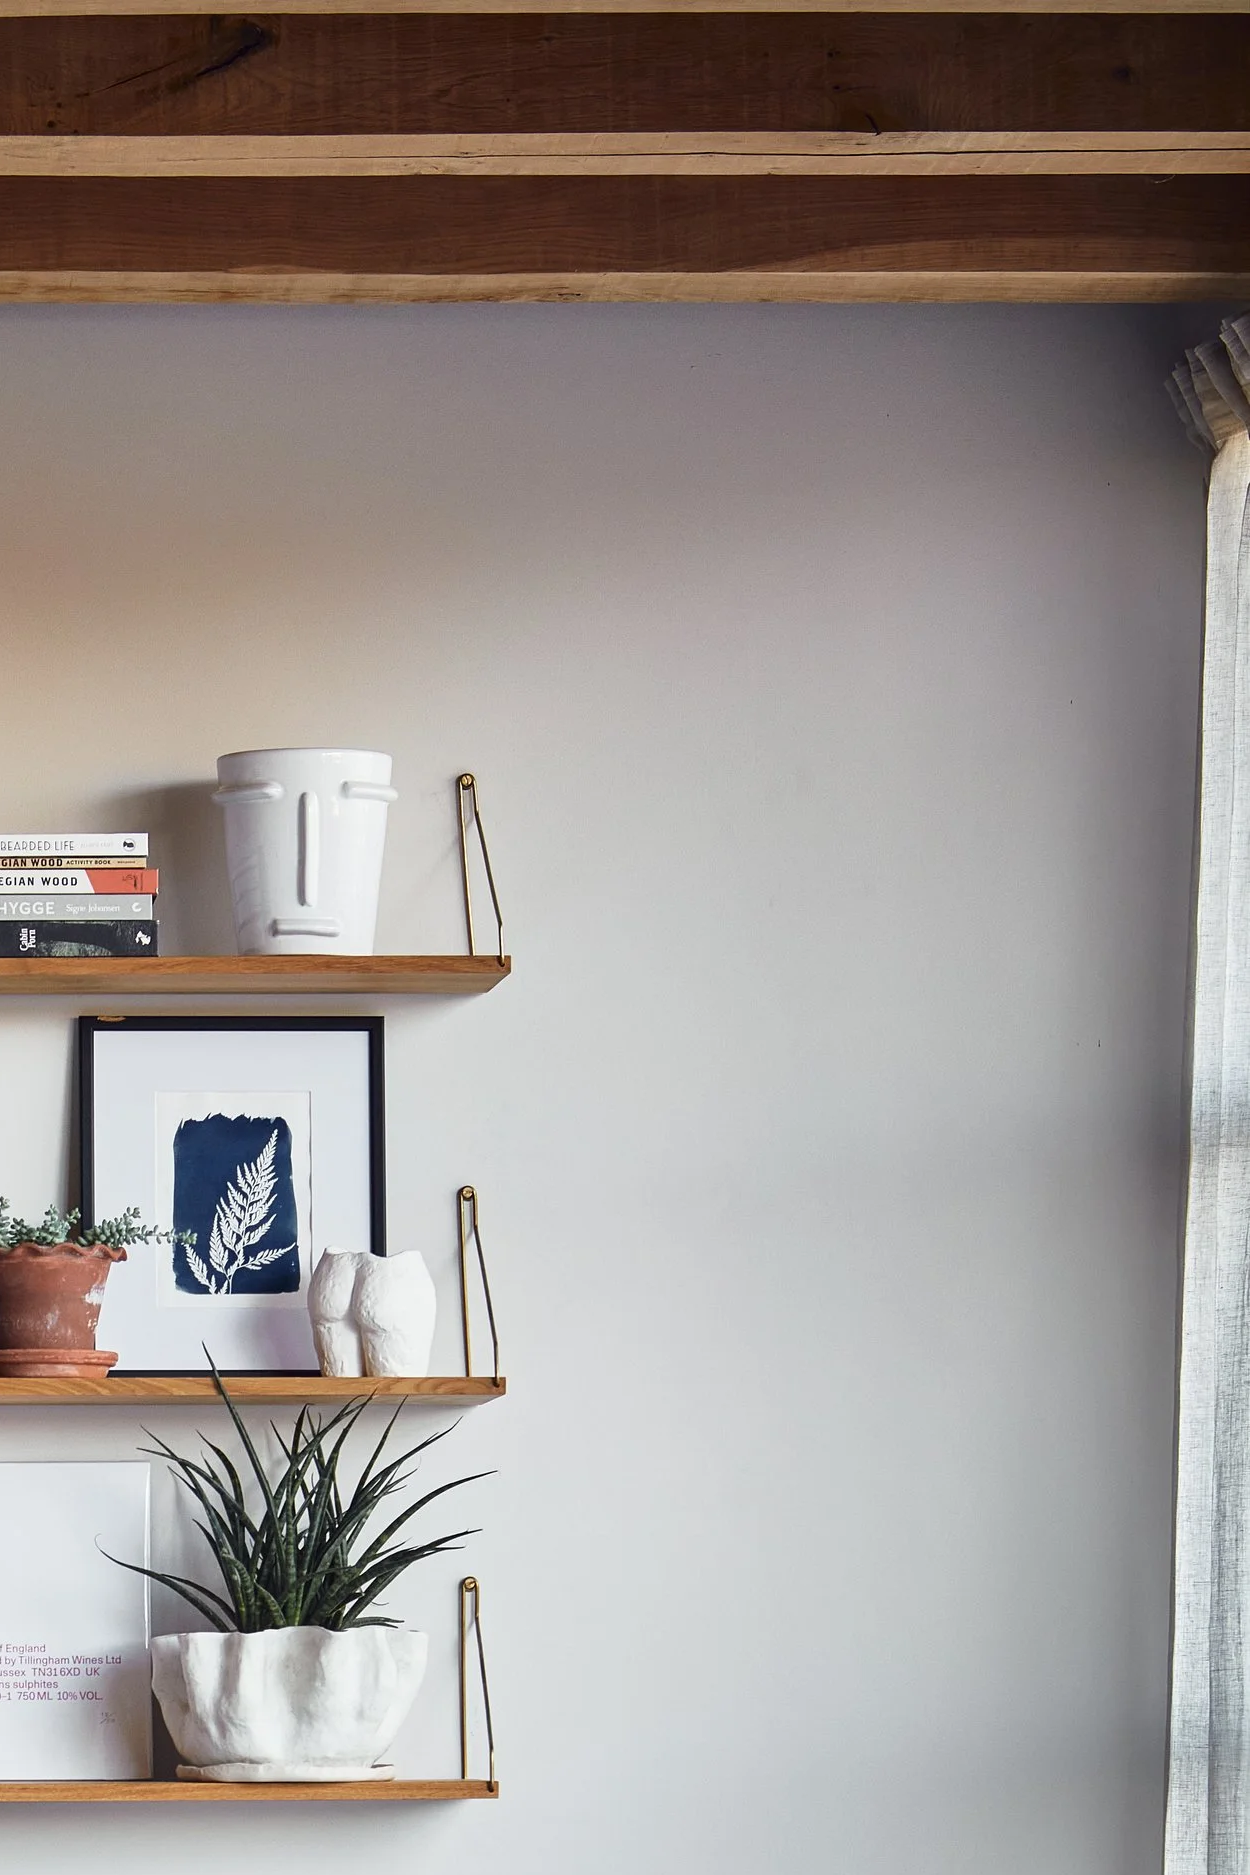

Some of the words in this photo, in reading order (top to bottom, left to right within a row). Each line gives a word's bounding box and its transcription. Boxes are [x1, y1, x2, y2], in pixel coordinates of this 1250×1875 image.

[0, 841, 50, 851] BEARDED
[54, 840, 75, 851] LIFE
[31, 859, 63, 867] WOOD
[41, 877, 78, 886] WOOD
[66, 904, 86, 914] Signe
[88, 904, 120, 913] Johansen
[19, 928, 29, 951] Cabin
[27, 929, 36, 948] Porn
[5, 1644, 46, 1655] England
[4, 1656, 16, 1667] by
[18, 1656, 70, 1667] Tillingham
[72, 1655, 104, 1665] Wines
[105, 1655, 122, 1665] Ltd
[85, 1667, 100, 1677] UK
[12, 1680, 59, 1691] sulphites
[79, 1691, 103, 1701] VOL.
